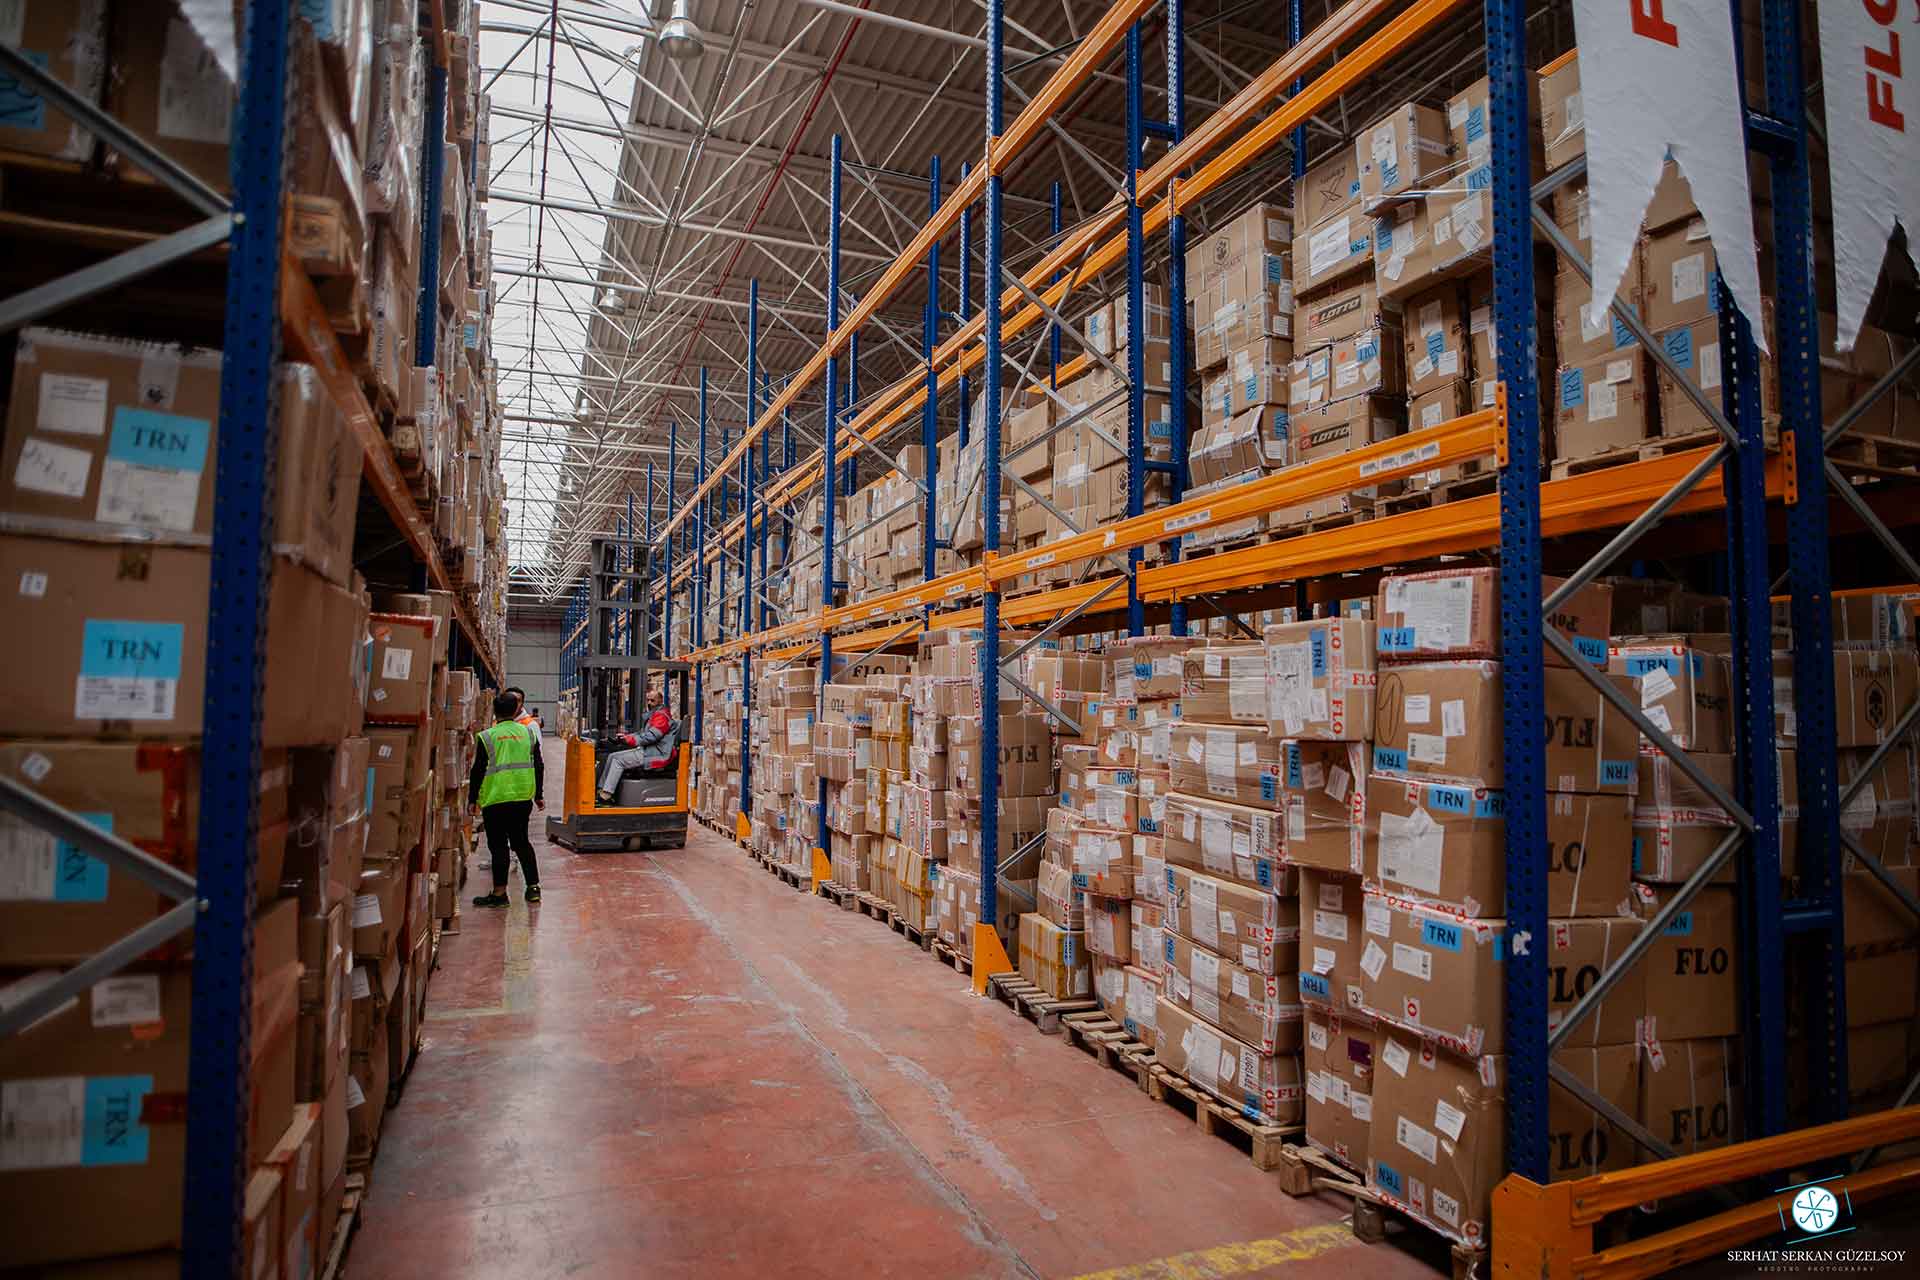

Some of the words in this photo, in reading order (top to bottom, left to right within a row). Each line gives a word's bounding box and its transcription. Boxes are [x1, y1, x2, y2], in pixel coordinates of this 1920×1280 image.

[1671, 331, 1689, 365] TRN
[1564, 370, 1582, 405] TRN
[130, 425, 190, 453] TRN
[101, 638, 163, 661] TRN
[1312, 640, 1322, 669] TRN
[1578, 641, 1603, 658] TRN
[1332, 700, 1343, 735] FLO
[1290, 750, 1299, 778] TRN
[1377, 752, 1403, 769] TRN
[1606, 766, 1629, 780] TRN
[1436, 790, 1464, 810] TRN
[1140, 818, 1157, 832] TRN
[1672, 811, 1696, 823] FLO
[64, 842, 85, 884] RN
[1548, 842, 1587, 873] LO
[1429, 925, 1456, 946] TRN
[1670, 917, 1688, 929] RN
[1675, 948, 1729, 975] FLO
[1266, 976, 1276, 998] LO
[1303, 976, 1325, 994] TRN
[1548, 965, 1601, 1002] LO
[105, 1092, 130, 1148] TRN
[1671, 1102, 1730, 1145] FLO
[1379, 1167, 1400, 1192] TRN
